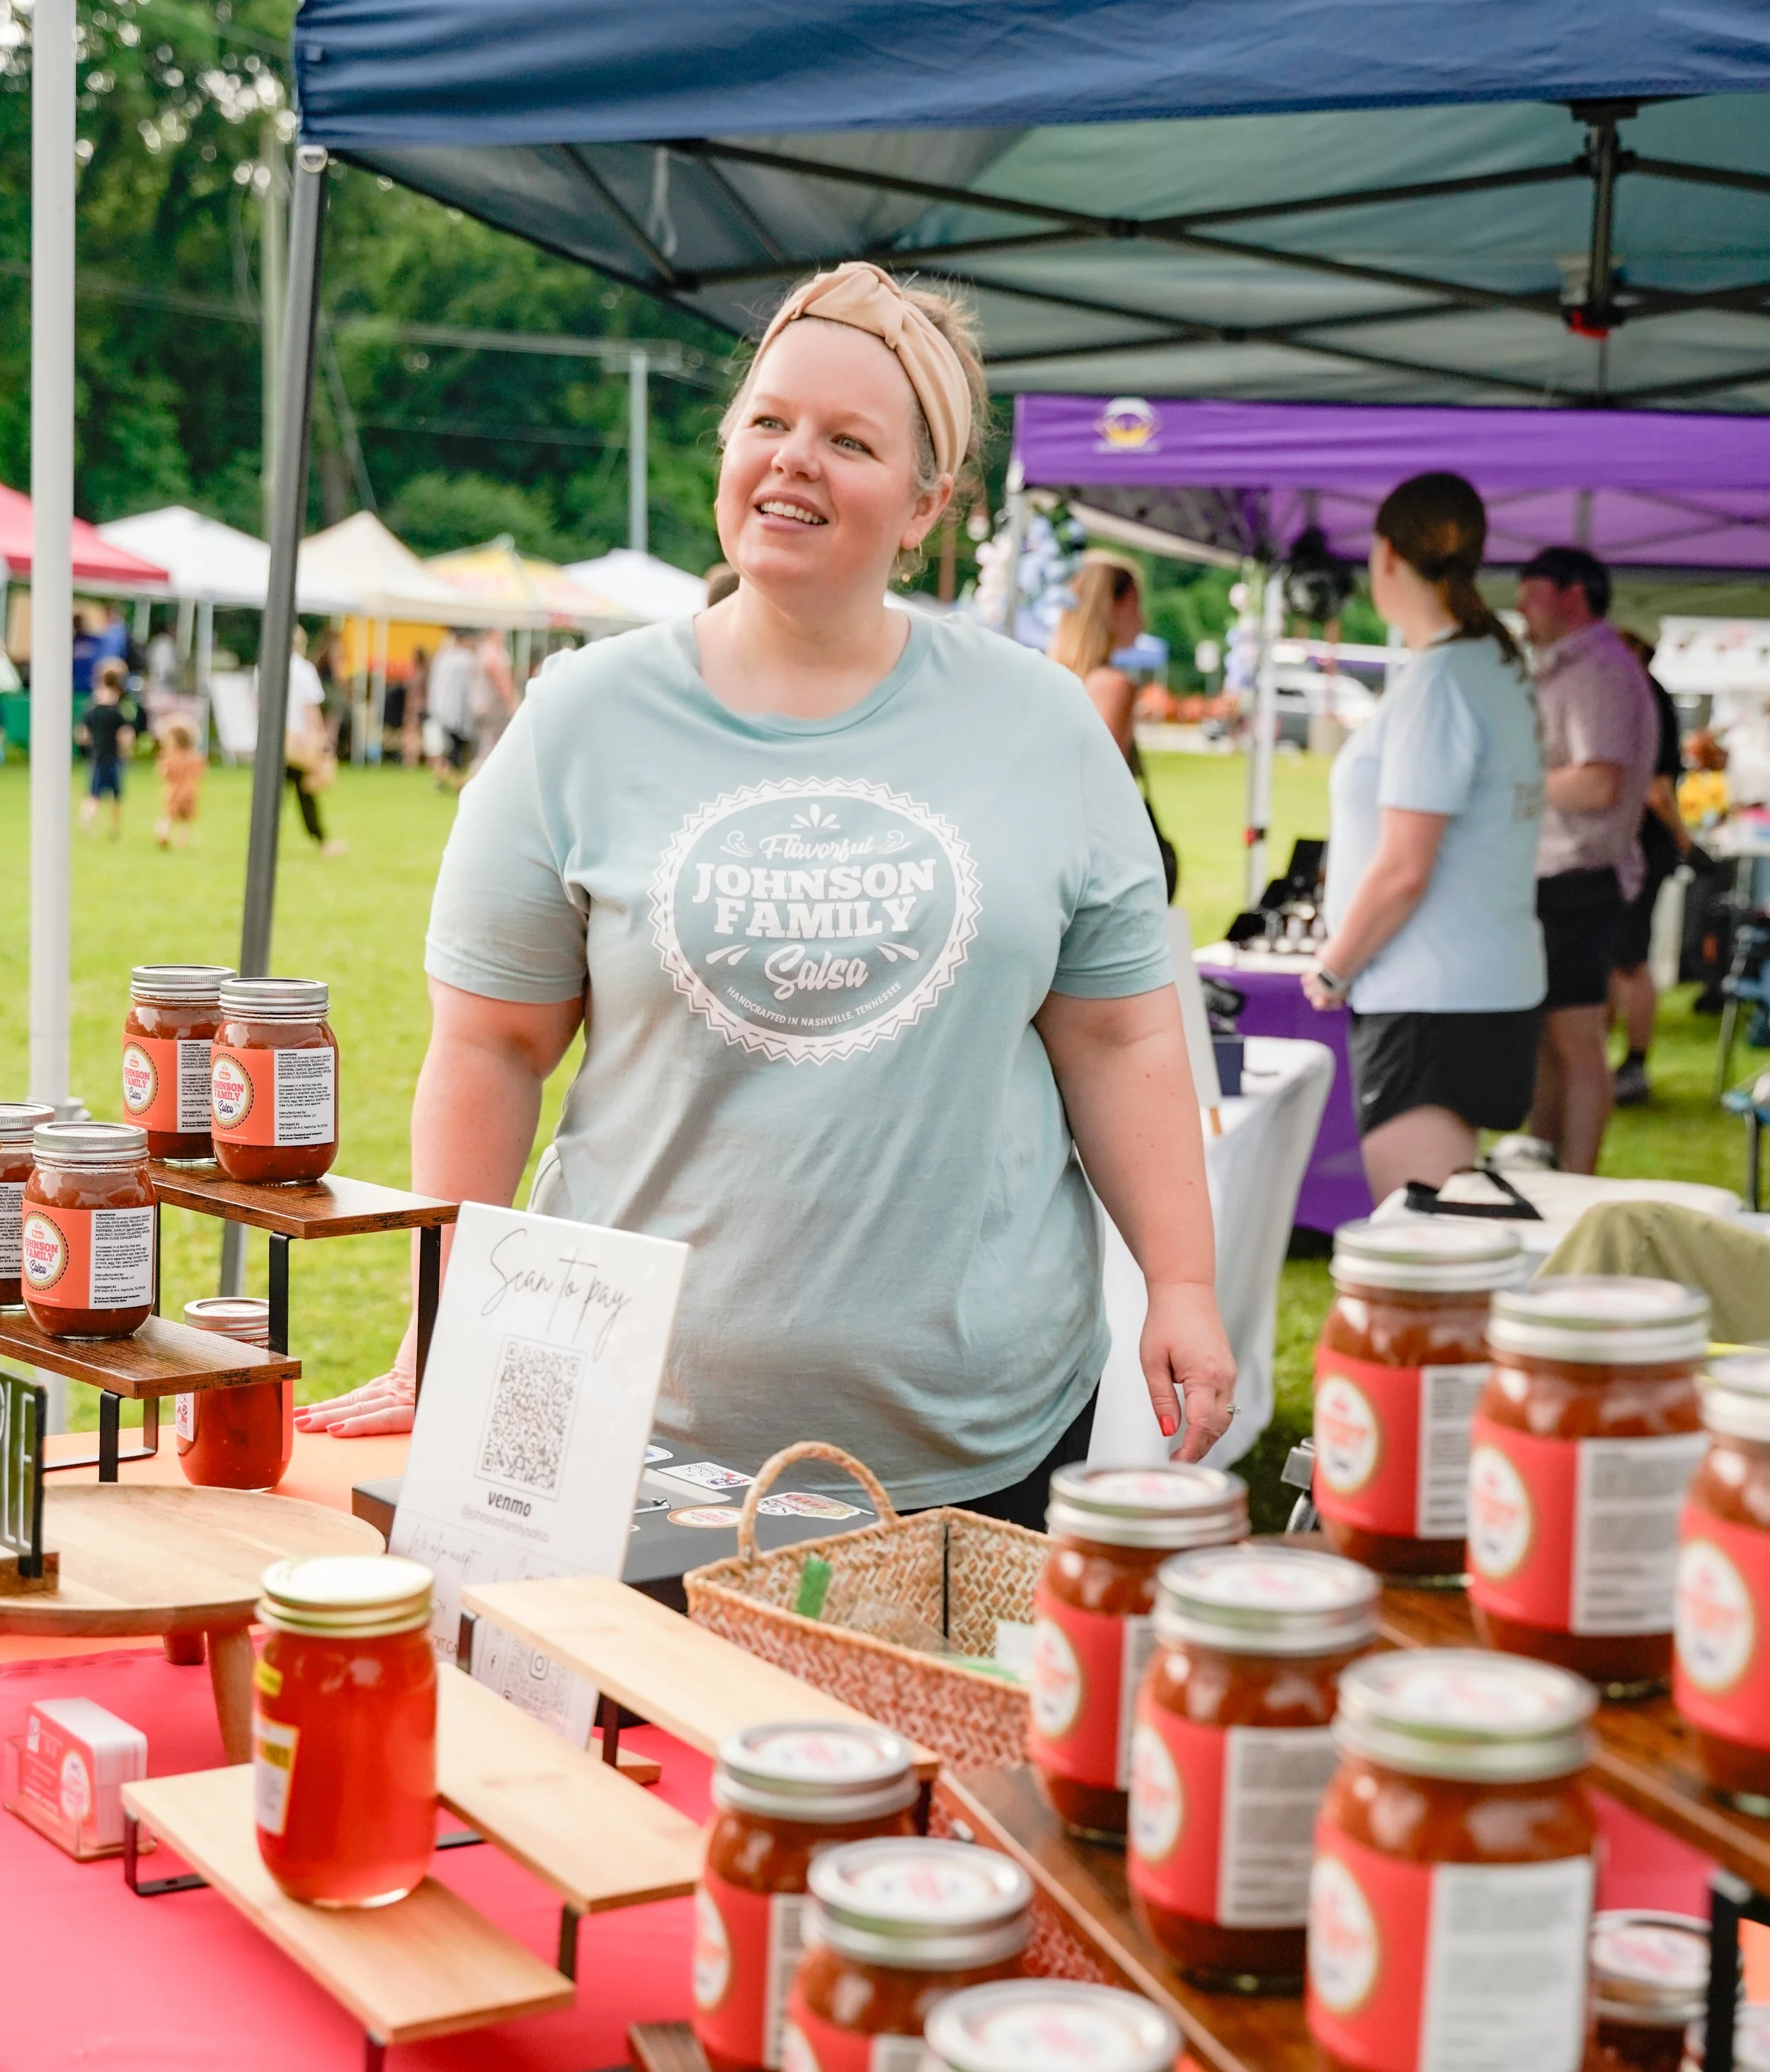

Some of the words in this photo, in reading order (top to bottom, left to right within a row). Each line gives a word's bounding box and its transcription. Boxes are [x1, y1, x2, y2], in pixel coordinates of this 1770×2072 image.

[759, 833, 875, 863] Flavorful
[692, 859, 936, 903] JOHNSON
[714, 896, 917, 939] FAMILY
[764, 944, 869, 1000] Salsa
[726, 986, 787, 1024] HANDCRAFTED
[788, 1017, 799, 1026] IN
[801, 1013, 855, 1026] NASHVILLE,
[855, 982, 903, 1016] TENNESSEE
[128, 1087, 142, 1100] Salsa
[215, 1089, 241, 1101] FAMILY
[218, 1100, 234, 1114] Salsa
[26, 1247, 55, 1262] FAMILY
[30, 1259, 47, 1274] Salsa
[481, 1228, 554, 1317] Scan
[571, 1274, 632, 1362] pay
[0, 1381, 34, 1549] LE
[488, 1491, 532, 1516] venmo
